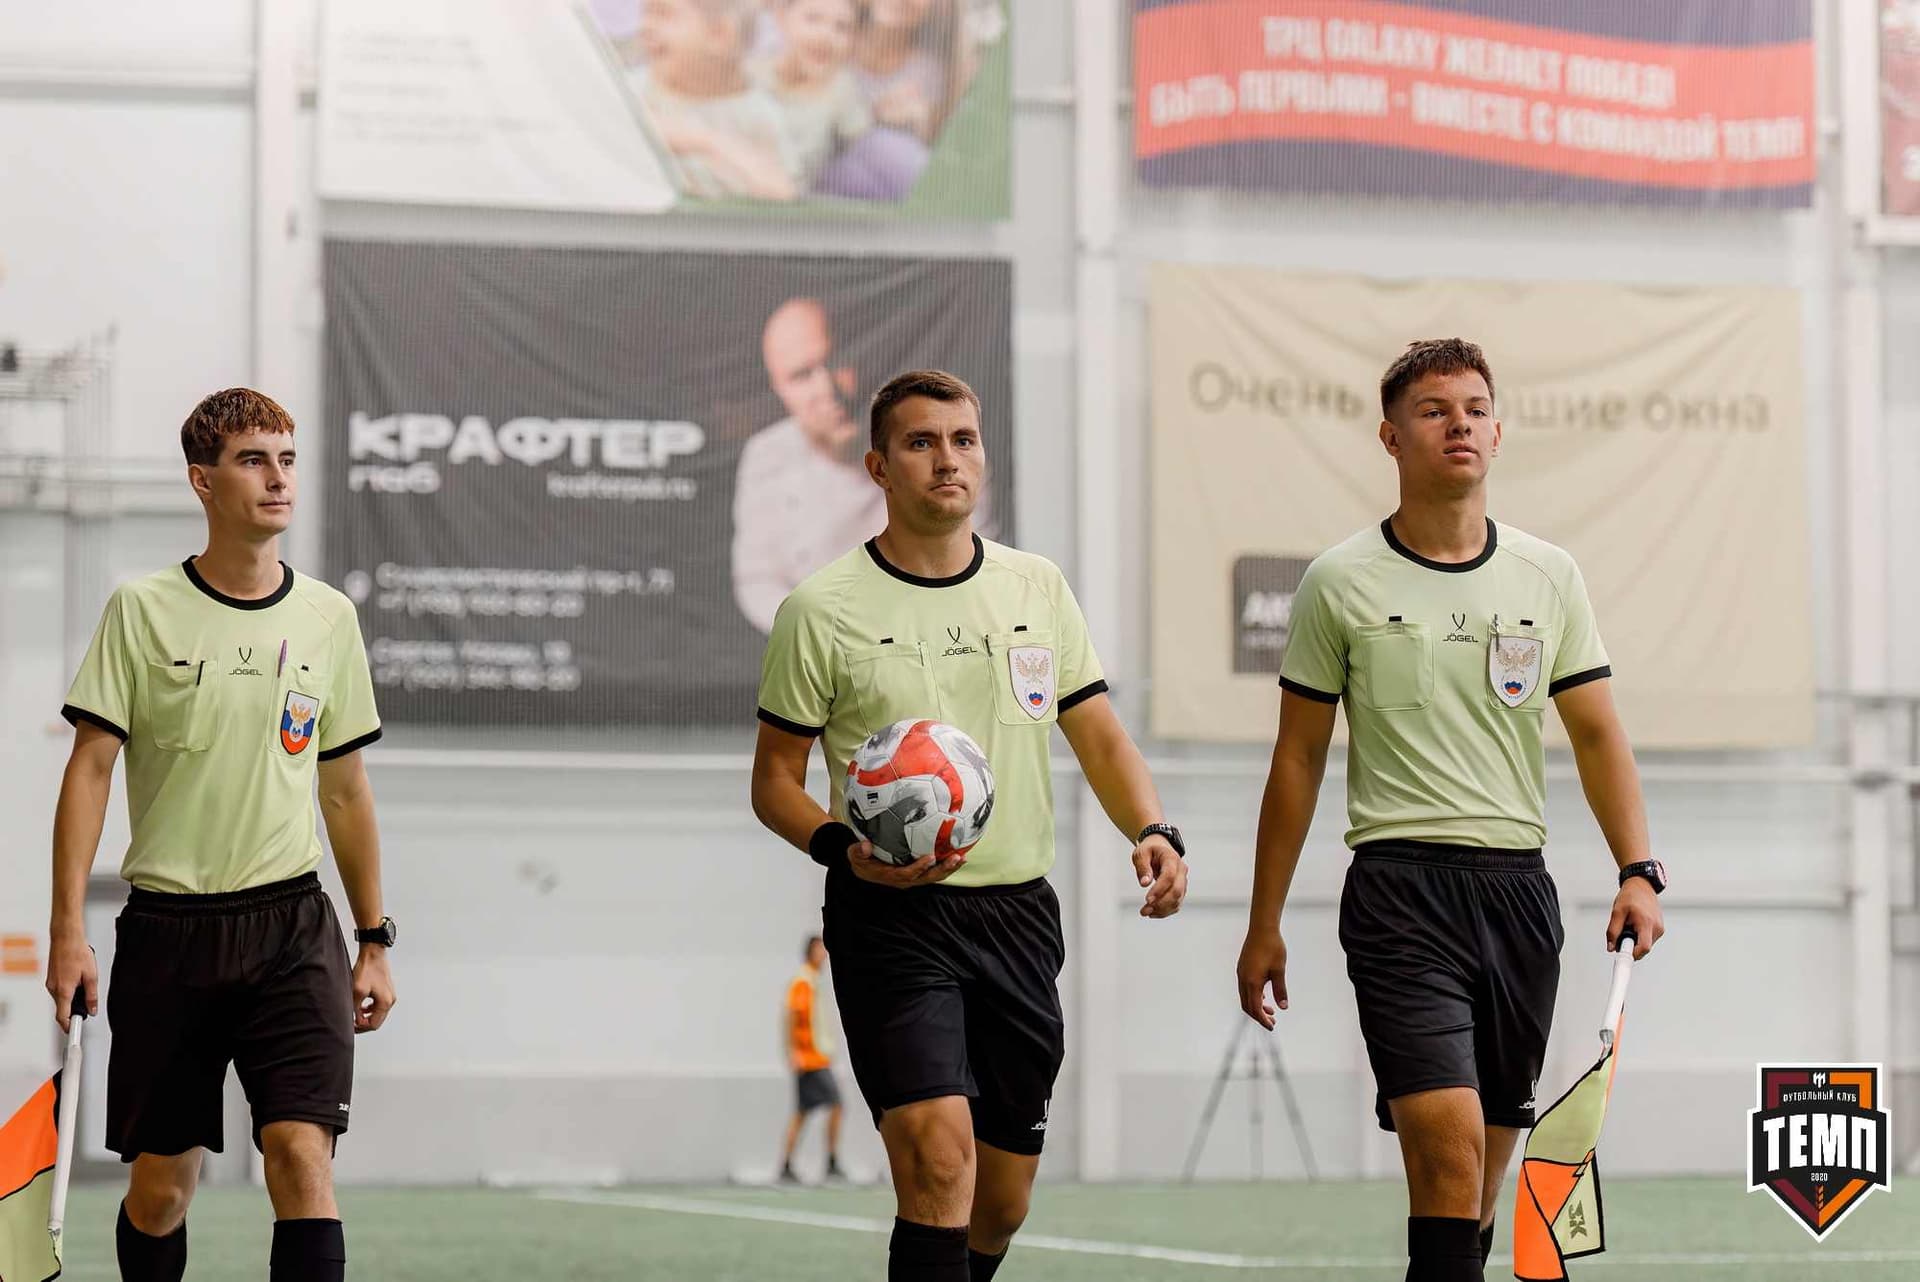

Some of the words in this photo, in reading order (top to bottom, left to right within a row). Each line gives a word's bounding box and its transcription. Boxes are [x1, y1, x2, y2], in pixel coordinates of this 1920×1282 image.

[1190, 362, 1365, 422] Очень
[1641, 391, 1771, 433] окна
[348, 411, 705, 468] КРАФТЕР
[1443, 633, 1479, 642] JÖGEL
